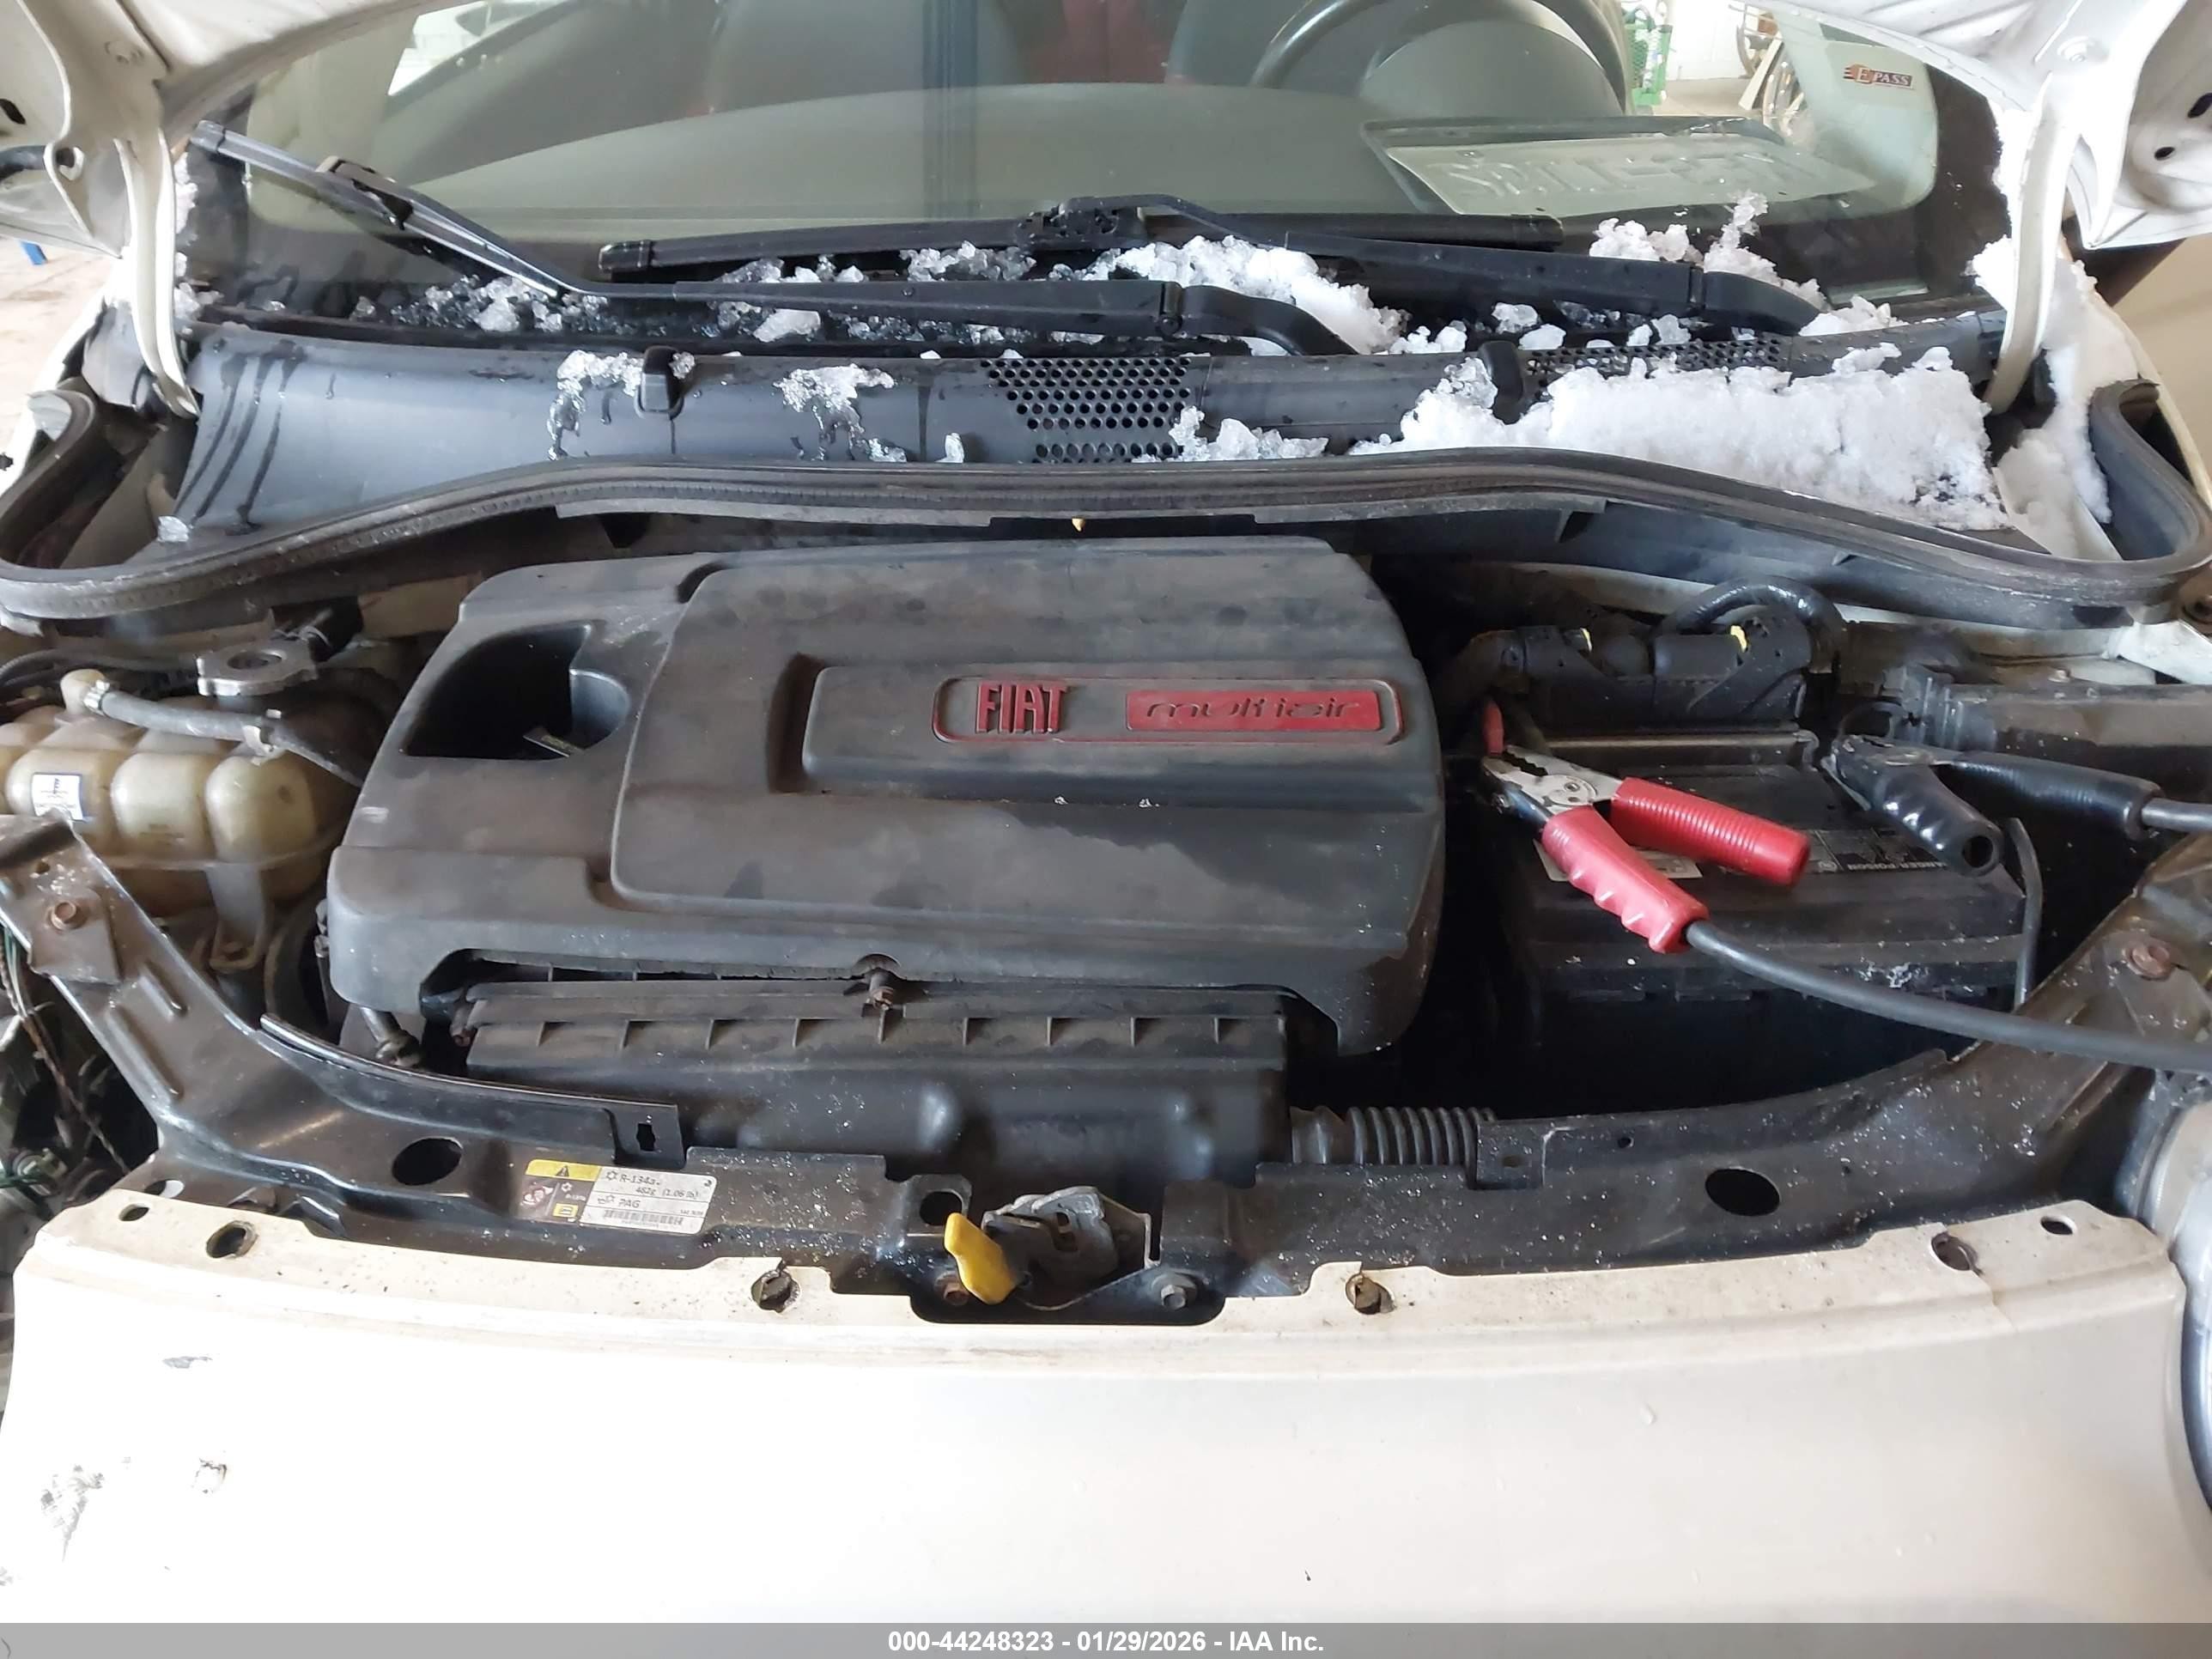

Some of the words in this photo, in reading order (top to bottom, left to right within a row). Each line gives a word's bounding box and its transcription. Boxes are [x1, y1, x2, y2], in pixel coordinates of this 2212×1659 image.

[1874, 71, 1909, 85] PASS
[975, 681, 1067, 734] FIAT
[1146, 696, 1361, 720] multiair
[618, 1199, 641, 1209] PAG
